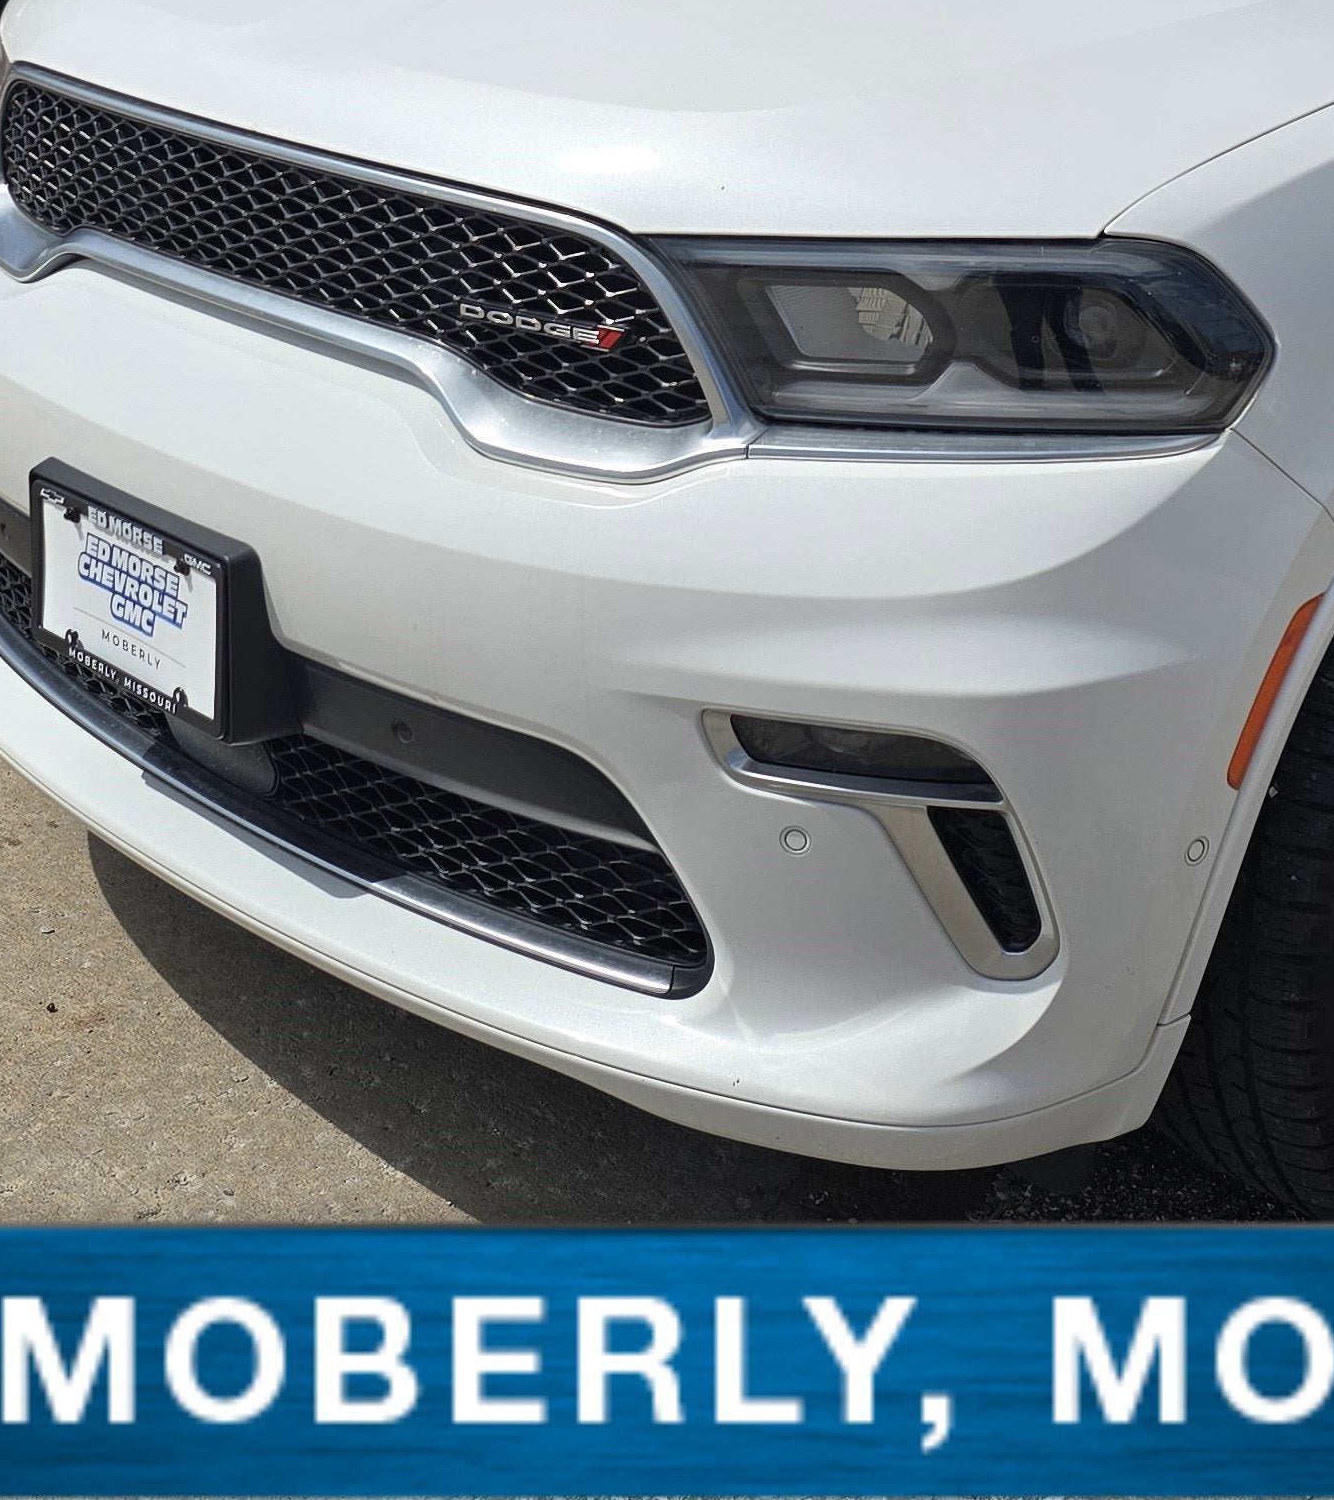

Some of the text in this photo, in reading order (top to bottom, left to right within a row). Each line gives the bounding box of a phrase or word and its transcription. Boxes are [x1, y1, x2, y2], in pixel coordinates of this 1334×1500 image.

[459, 303, 600, 345] DODGE
[87, 505, 165, 554] ED MORSE
[86, 532, 181, 599] ED MORSE
[183, 554, 212, 575] GMC
[78, 551, 189, 629] CHEVROLET
[110, 593, 157, 637] GMC
[101, 628, 162, 670] MOBERLY
[68, 647, 178, 714] MOBERLY, MISSOURI
